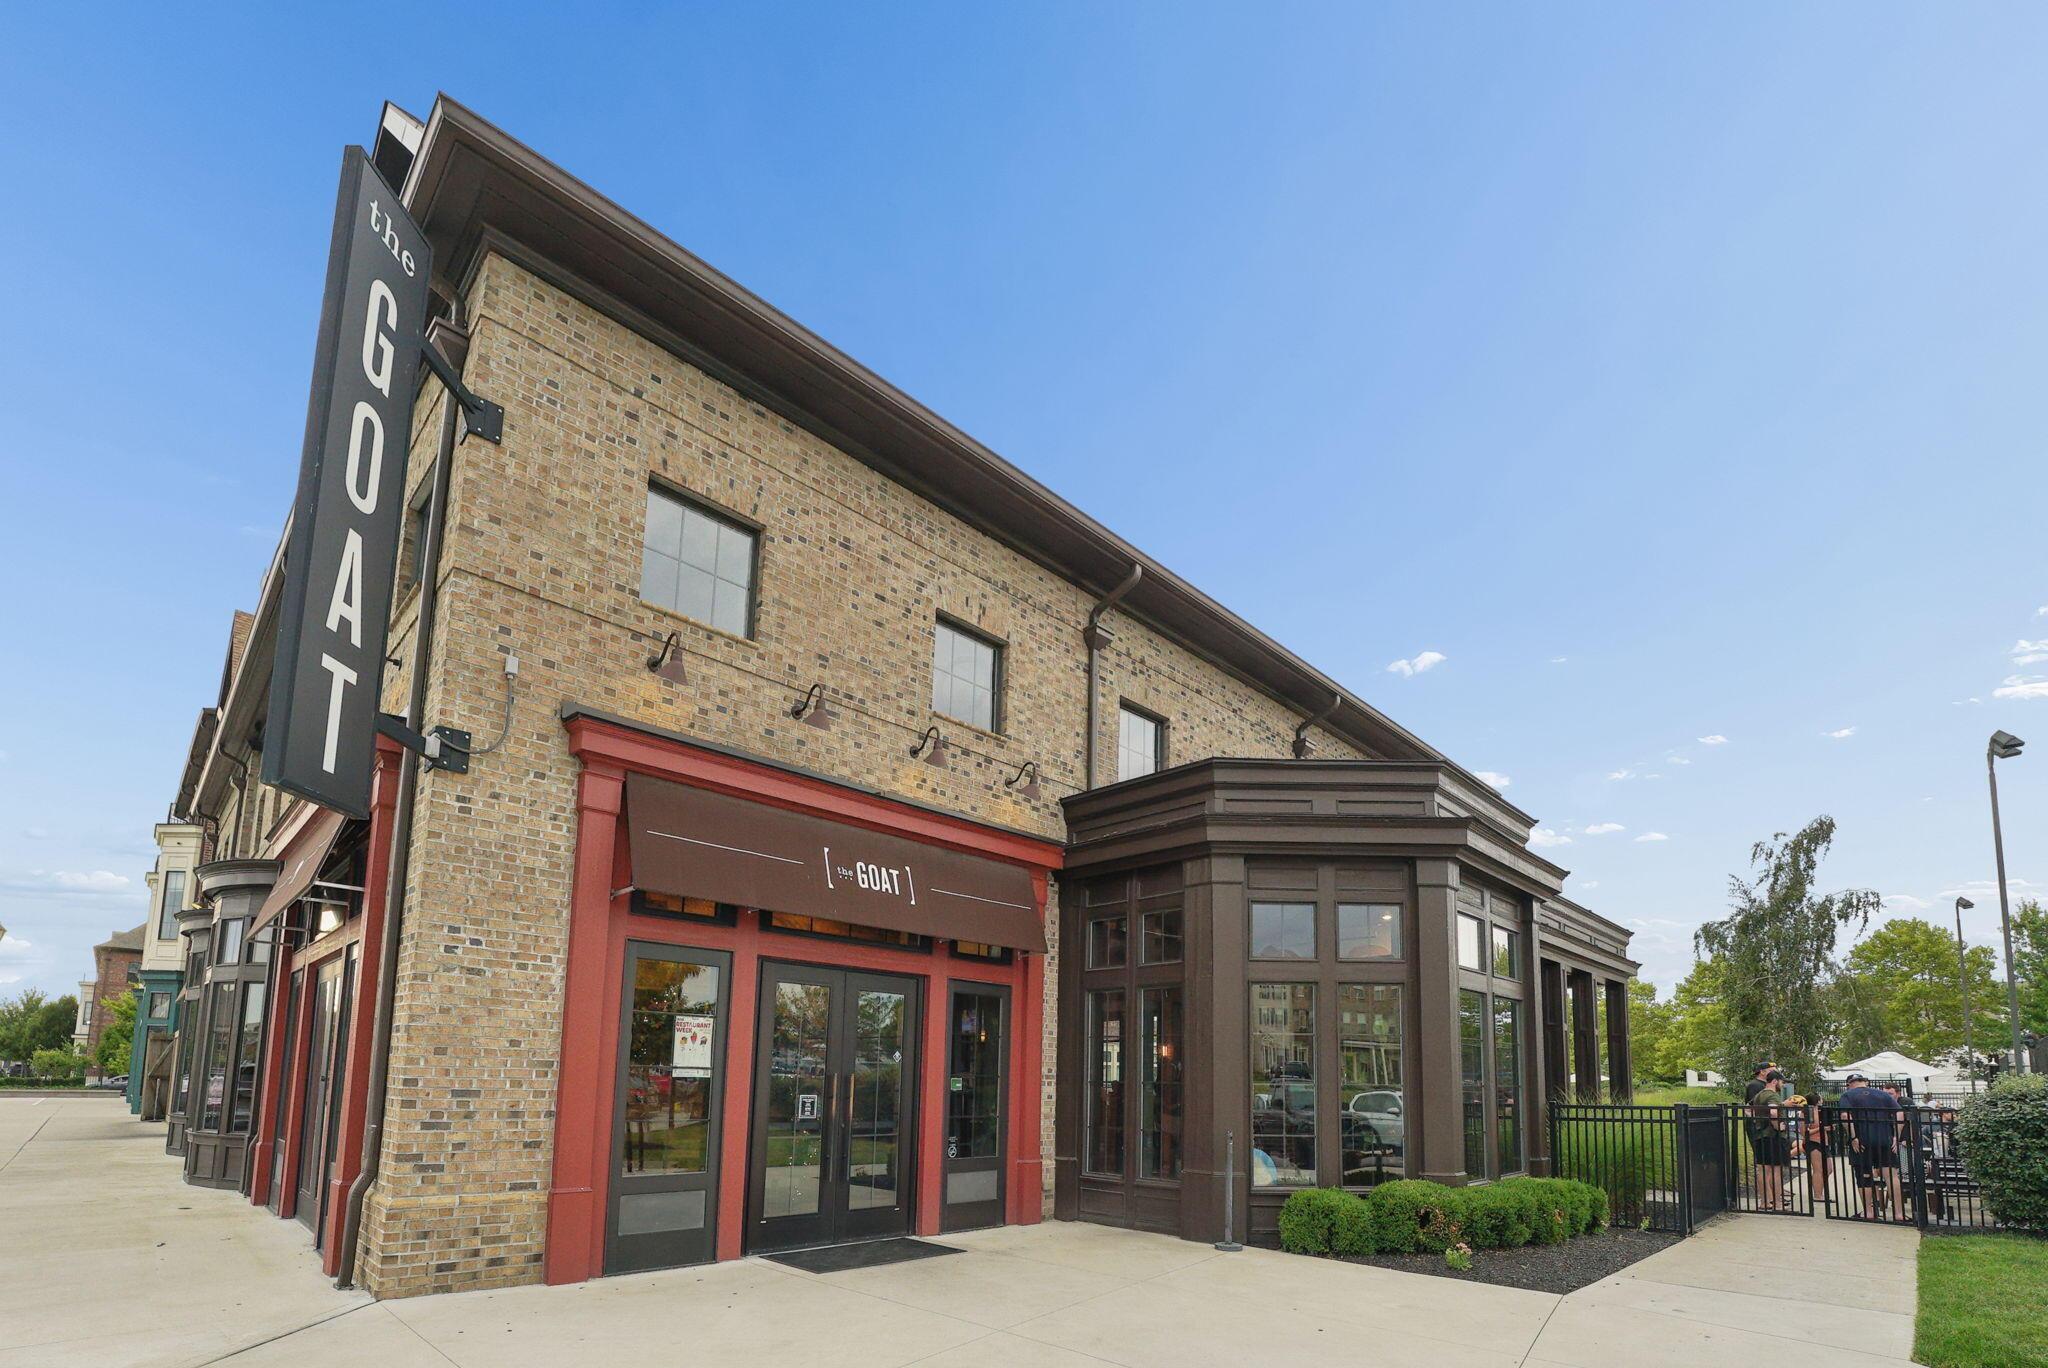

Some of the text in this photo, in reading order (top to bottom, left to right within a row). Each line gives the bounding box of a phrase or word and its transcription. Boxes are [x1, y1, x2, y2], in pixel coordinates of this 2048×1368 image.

[369, 199, 415, 277] the
[321, 279, 398, 774] GOAT
[837, 861, 900, 895] the GOAT
[675, 1021, 711, 1029] RESTAURANT
